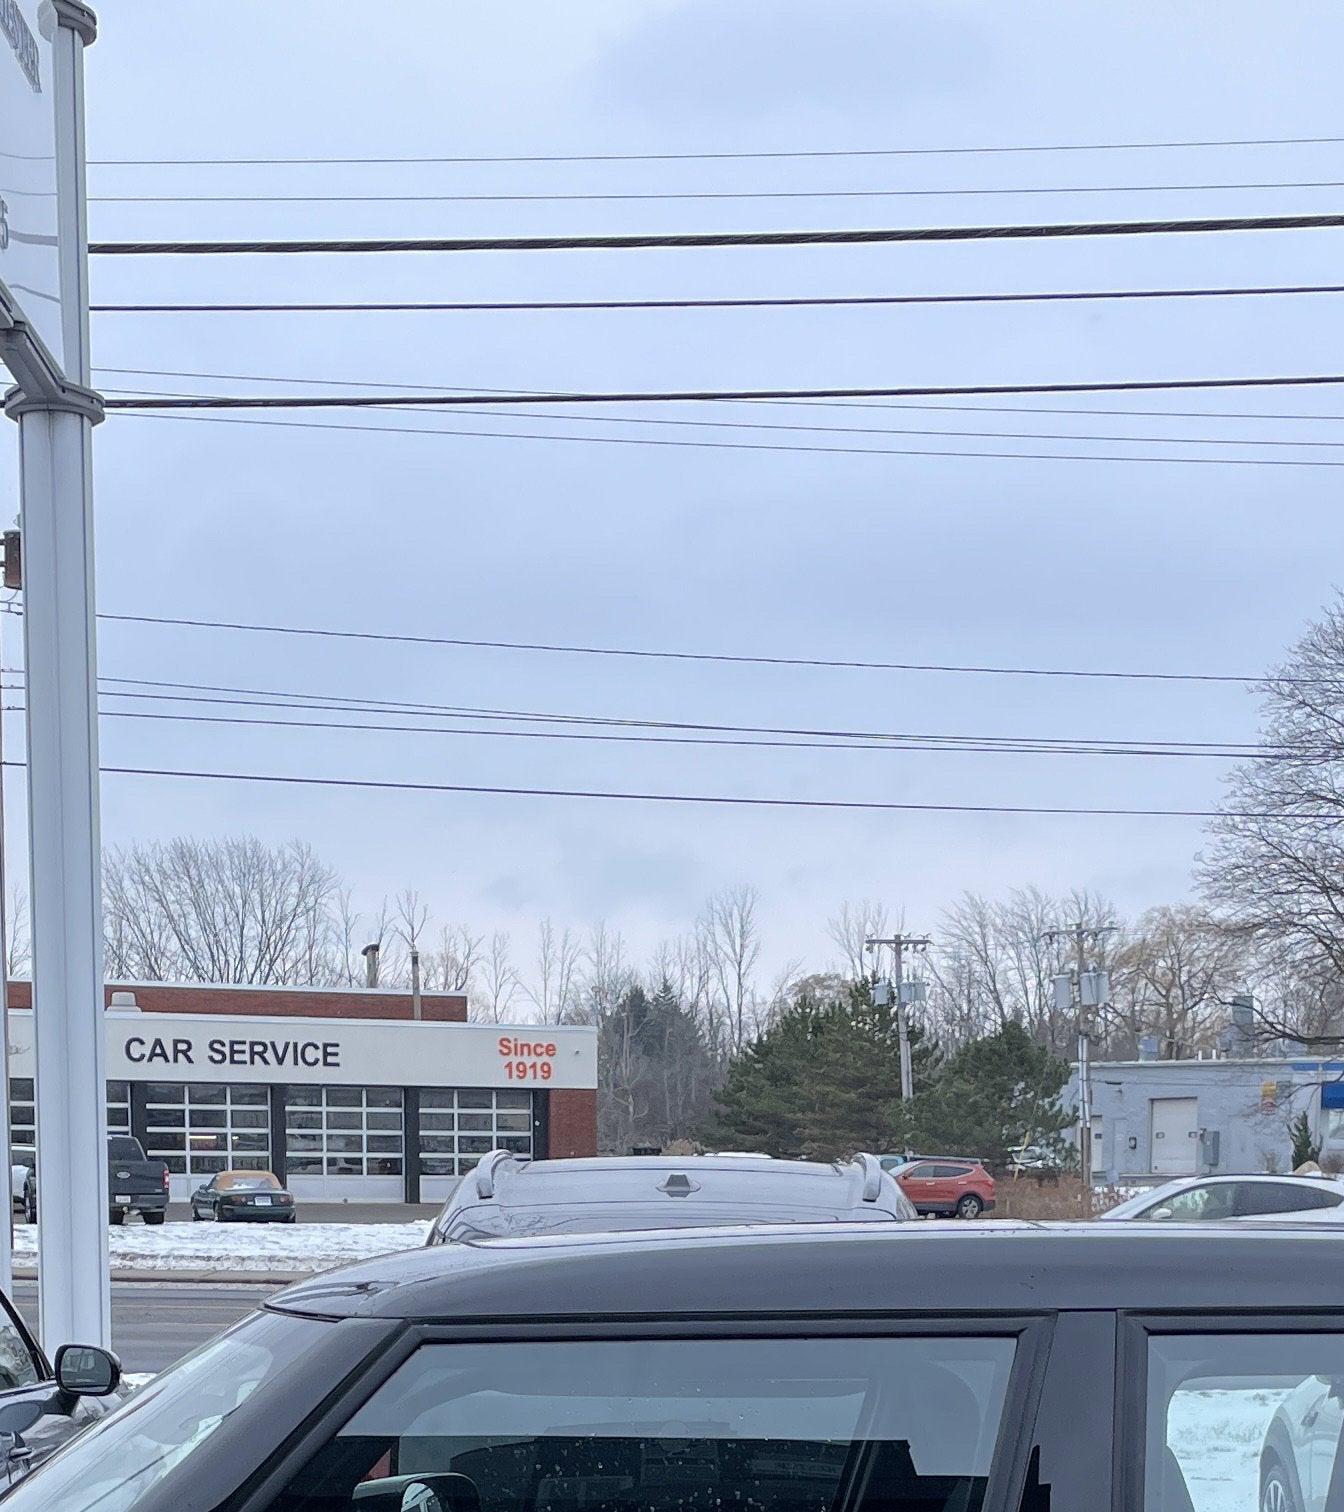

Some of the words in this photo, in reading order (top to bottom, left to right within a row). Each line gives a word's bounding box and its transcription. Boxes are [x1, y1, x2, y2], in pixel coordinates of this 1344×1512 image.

[124, 1036, 195, 1065] CAR
[207, 1038, 341, 1068] SERVICE
[498, 1036, 557, 1057] Since
[503, 1061, 552, 1080] 1919
